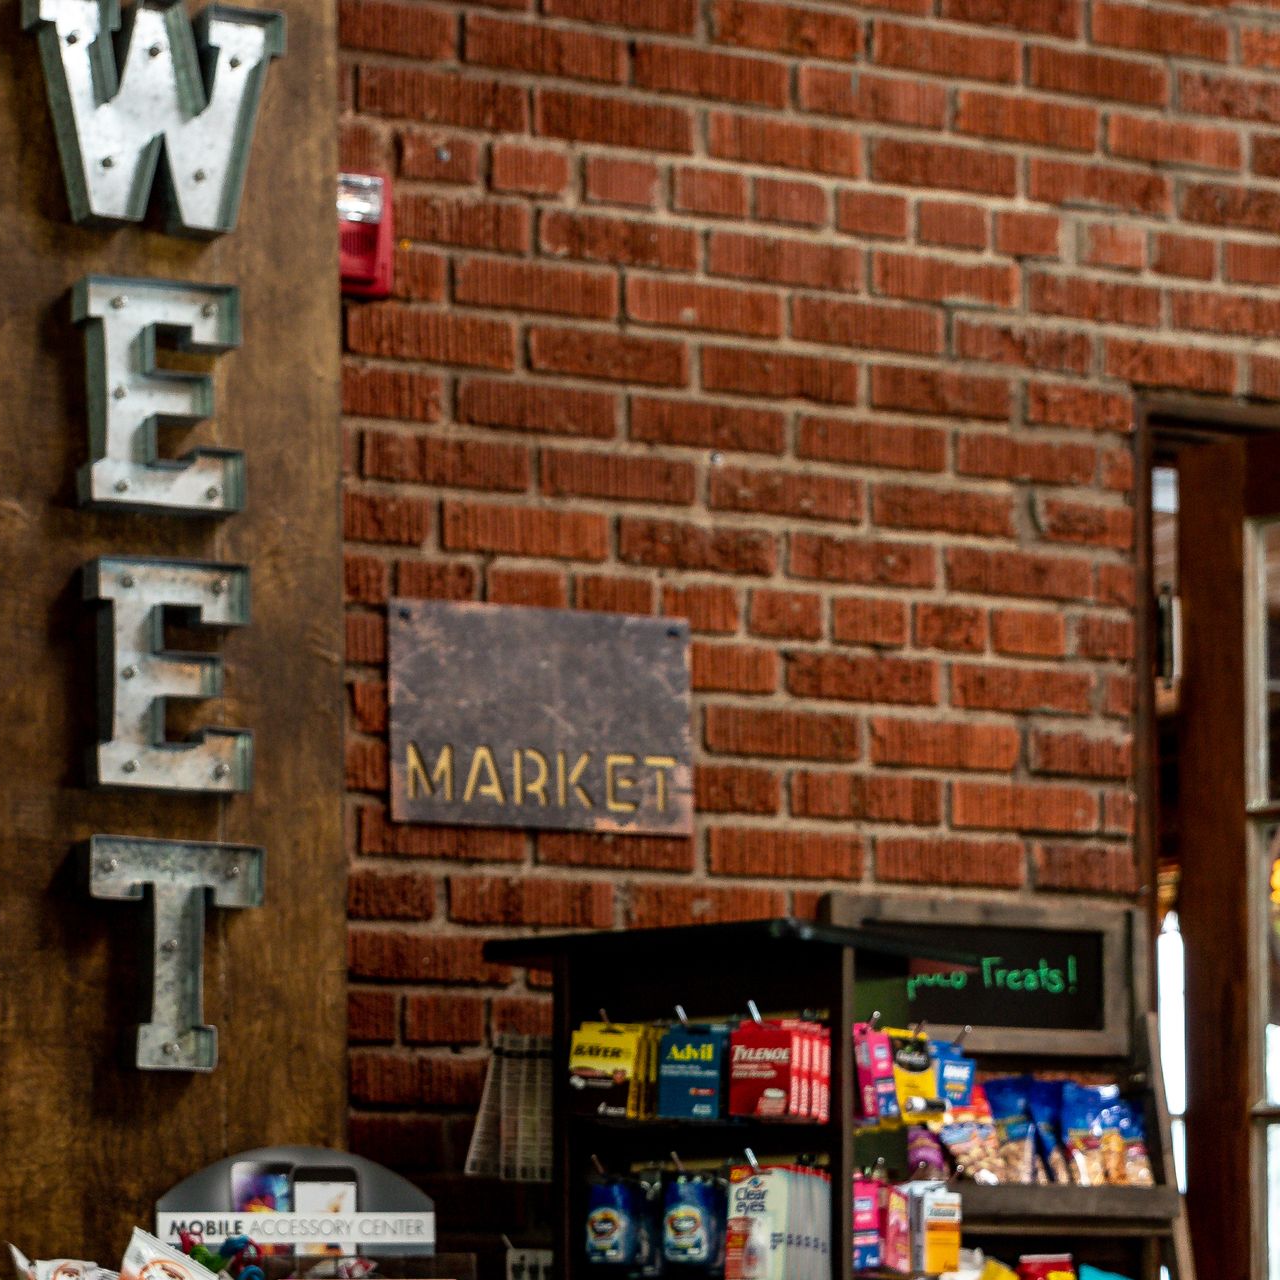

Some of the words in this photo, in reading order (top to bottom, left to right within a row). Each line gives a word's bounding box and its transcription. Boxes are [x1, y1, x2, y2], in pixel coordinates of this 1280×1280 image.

[406, 742, 677, 812] MARKET
[981, 955, 1078, 994] Treats!
[666, 1043, 714, 1062] Advil
[732, 1045, 791, 1062] TYLENOL
[734, 1187, 768, 1201] Clear
[169, 1220, 244, 1236] MOBILE
[249, 1219, 355, 1236] ACCESSORY
[358, 1219, 425, 1237] CENTER
